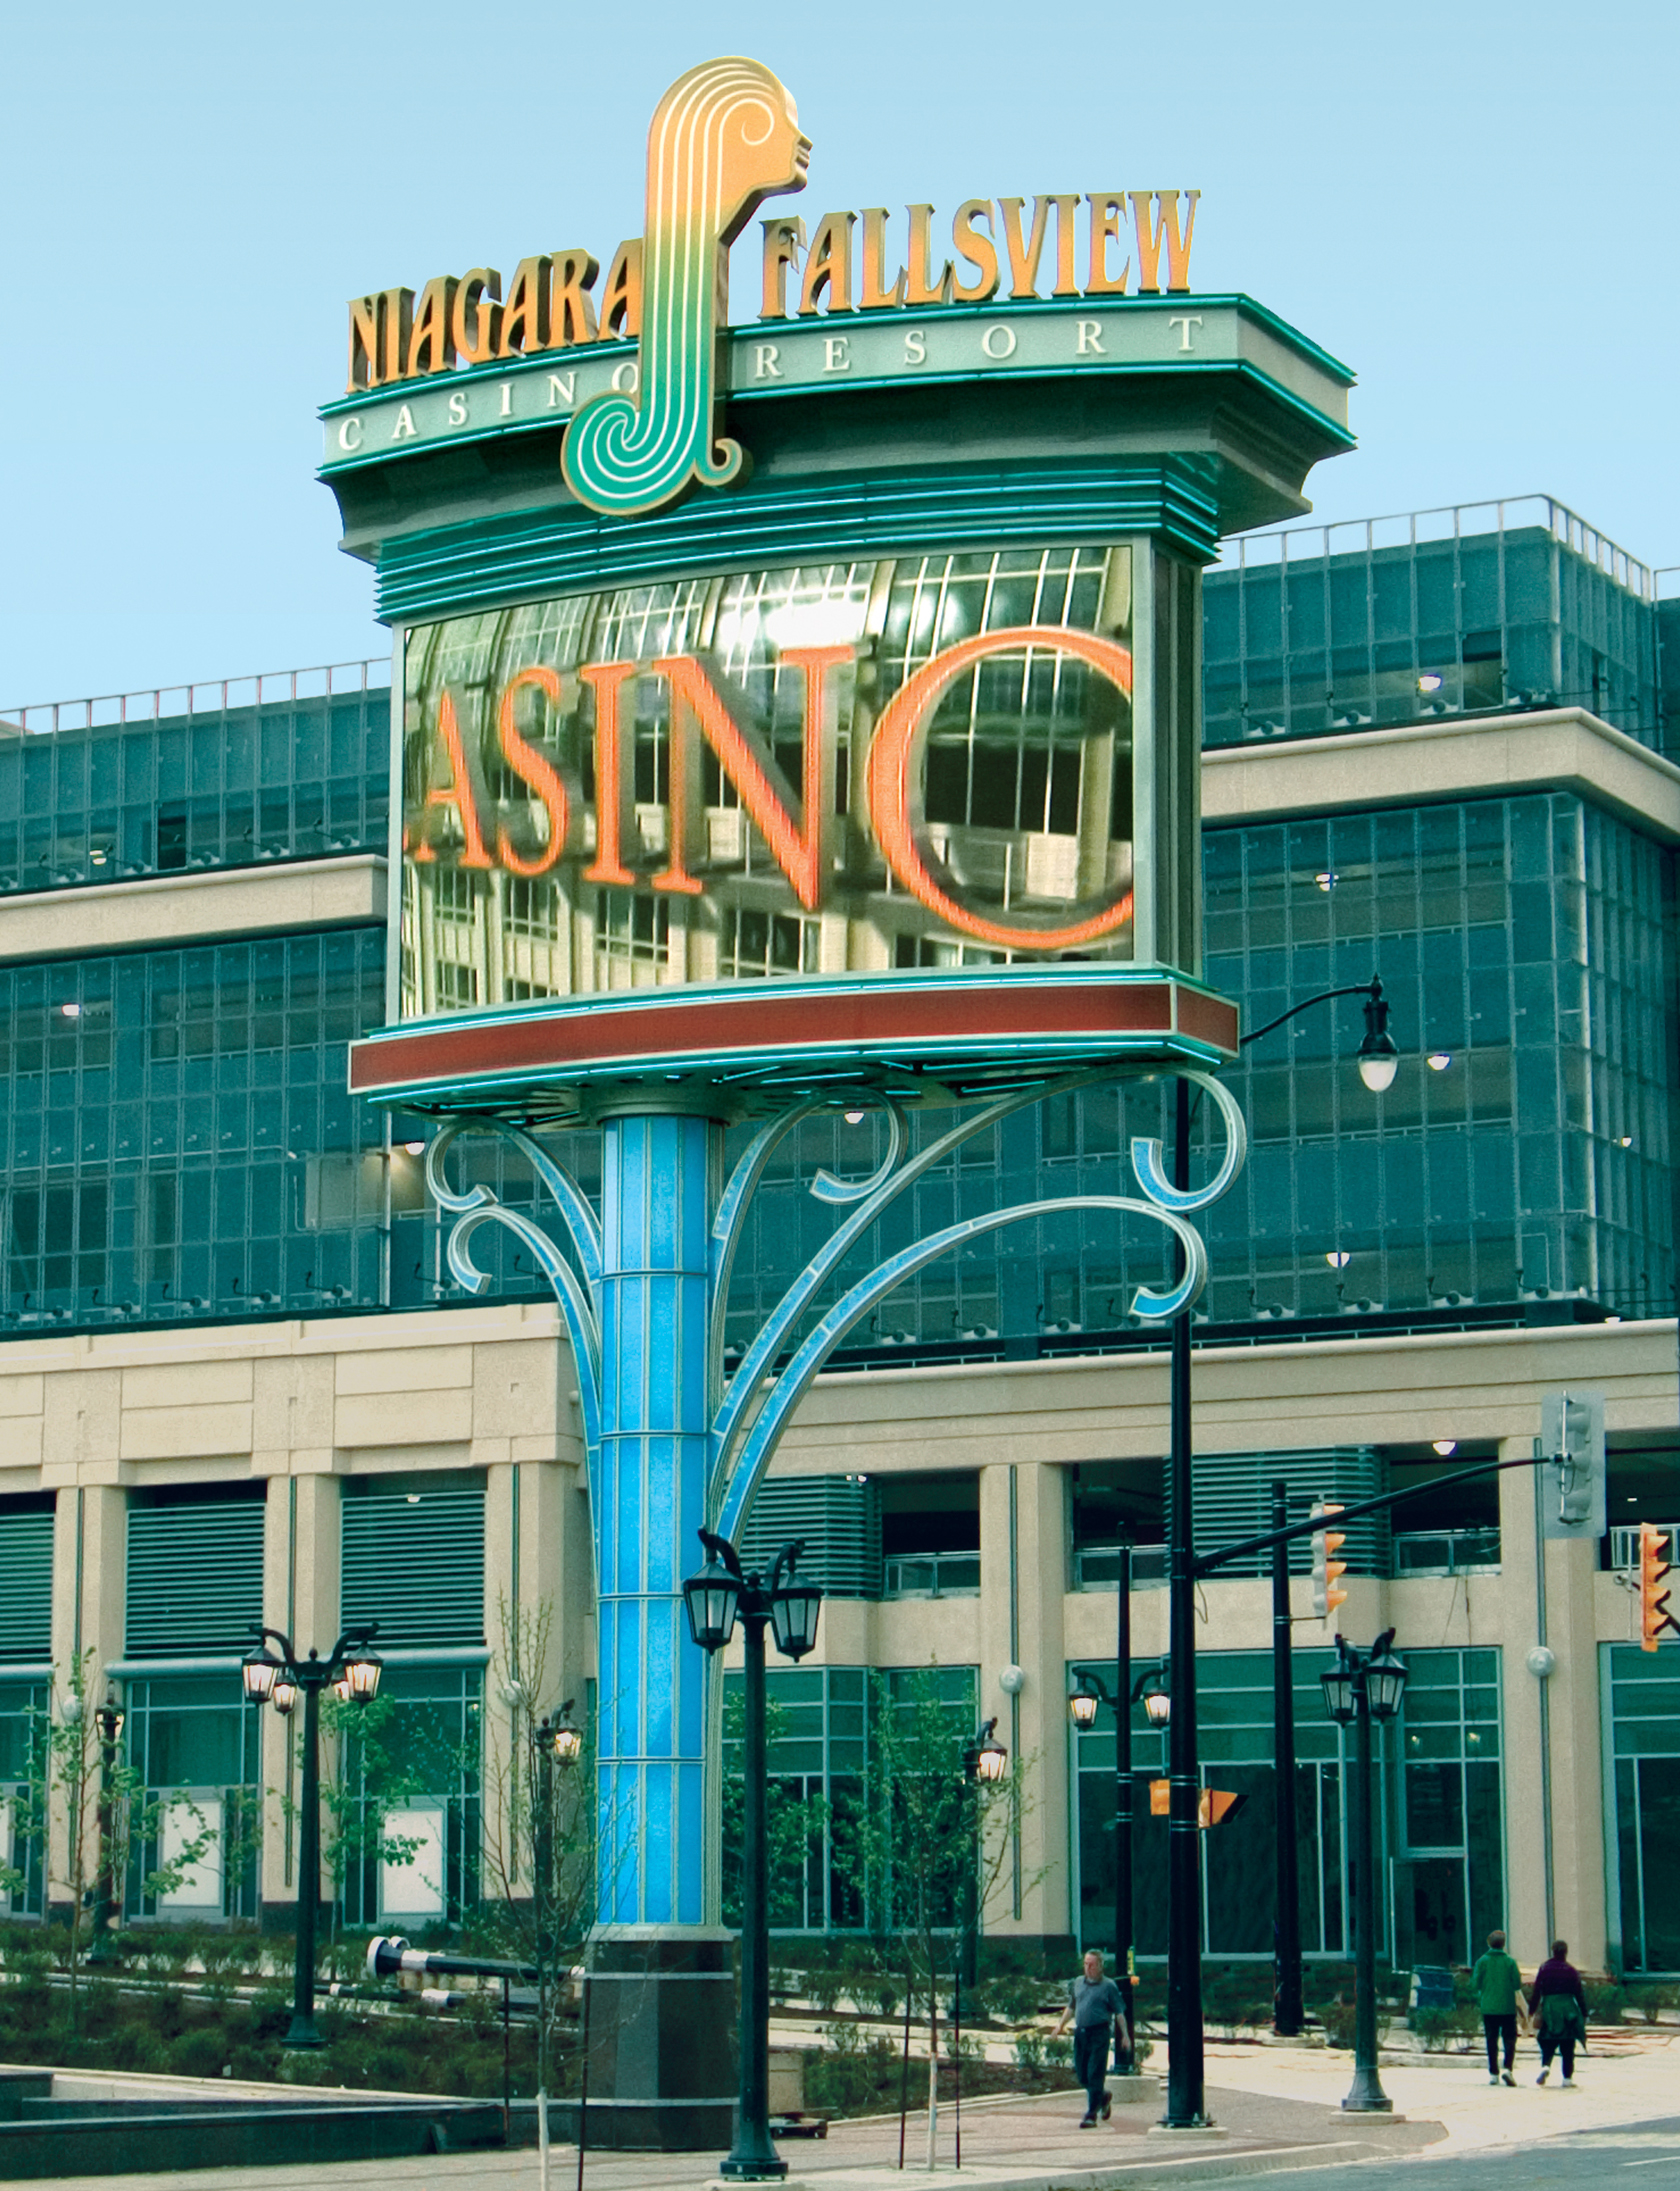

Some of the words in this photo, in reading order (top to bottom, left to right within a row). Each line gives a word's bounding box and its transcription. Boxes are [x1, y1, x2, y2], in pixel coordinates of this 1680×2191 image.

[338, 361, 640, 452] CASINO
[754, 315, 1203, 381] RESORT
[345, 237, 643, 394] NIAGARA
[757, 189, 1202, 321] FALLSVIEW
[403, 625, 1133, 950] ASINO
